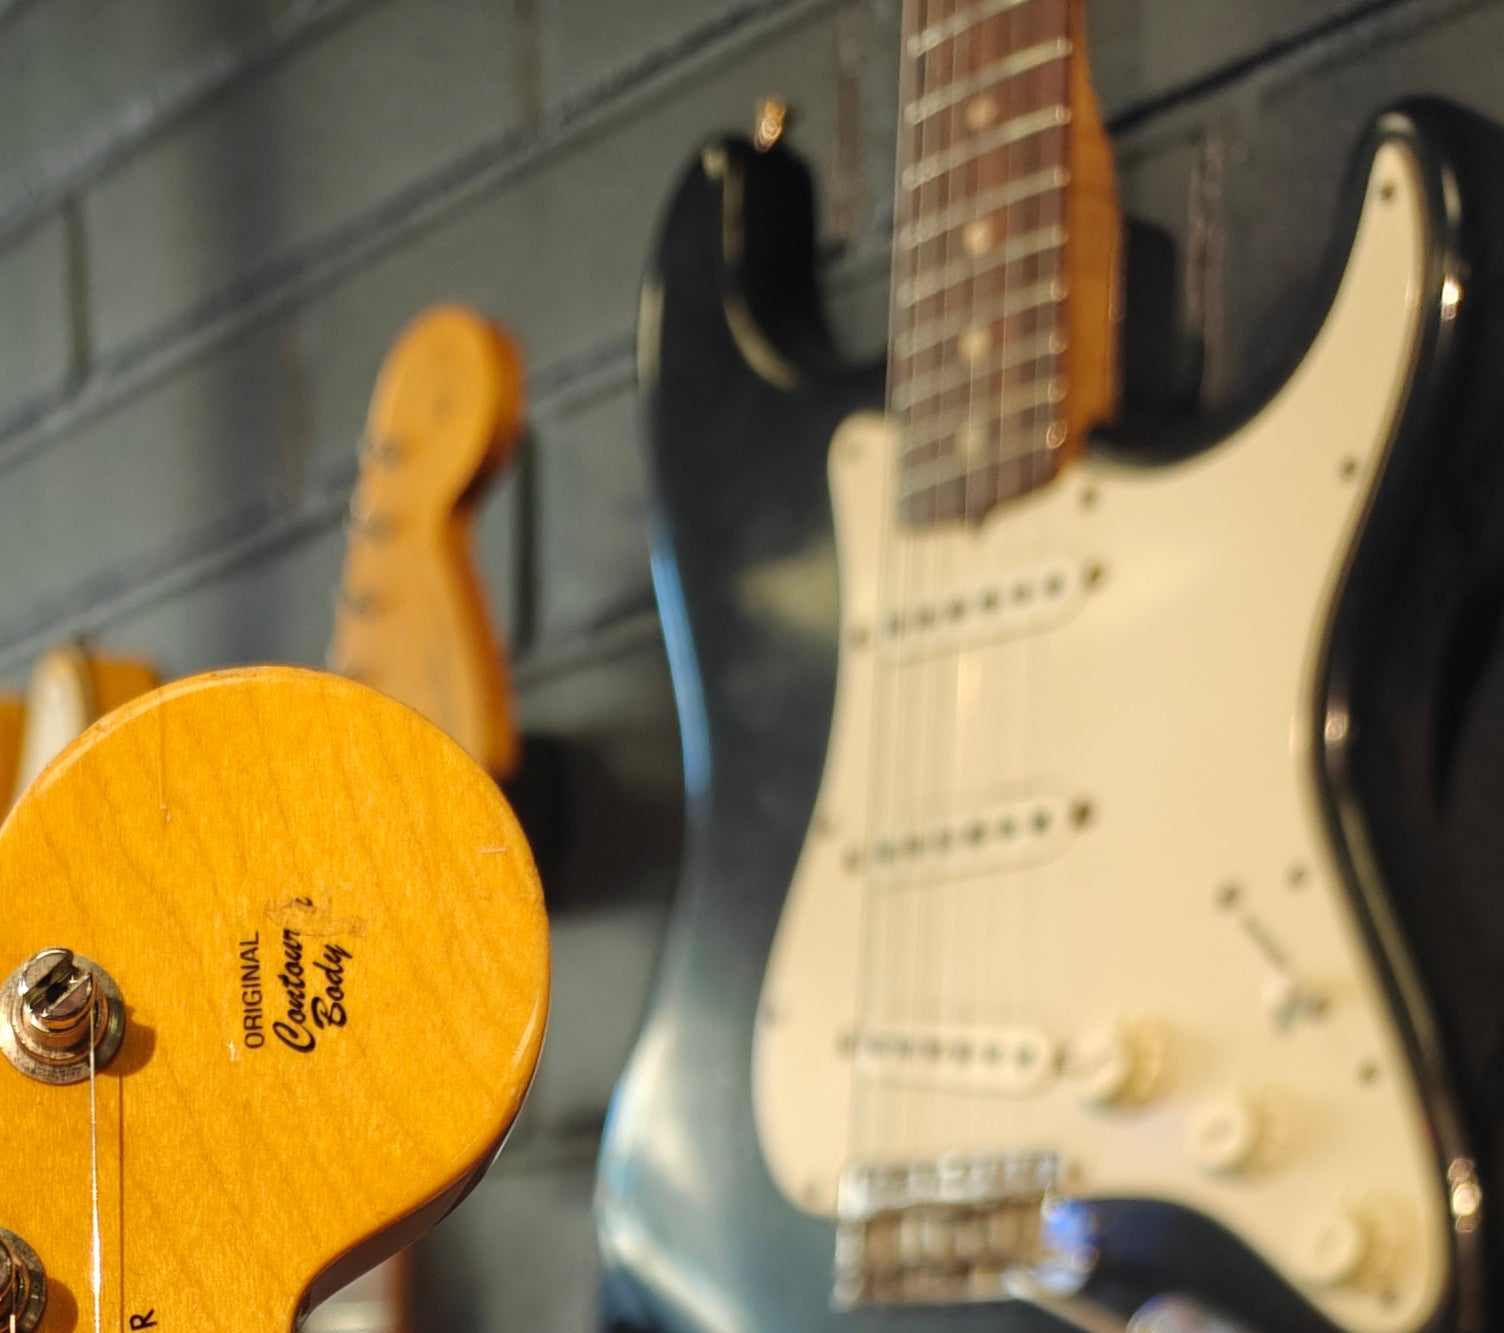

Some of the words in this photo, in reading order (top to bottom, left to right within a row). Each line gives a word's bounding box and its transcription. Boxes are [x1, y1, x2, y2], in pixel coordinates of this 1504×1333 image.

[239, 930, 265, 1049] ORIGINAL
[272, 928, 316, 1053] Contour
[311, 943, 353, 1029] Body
